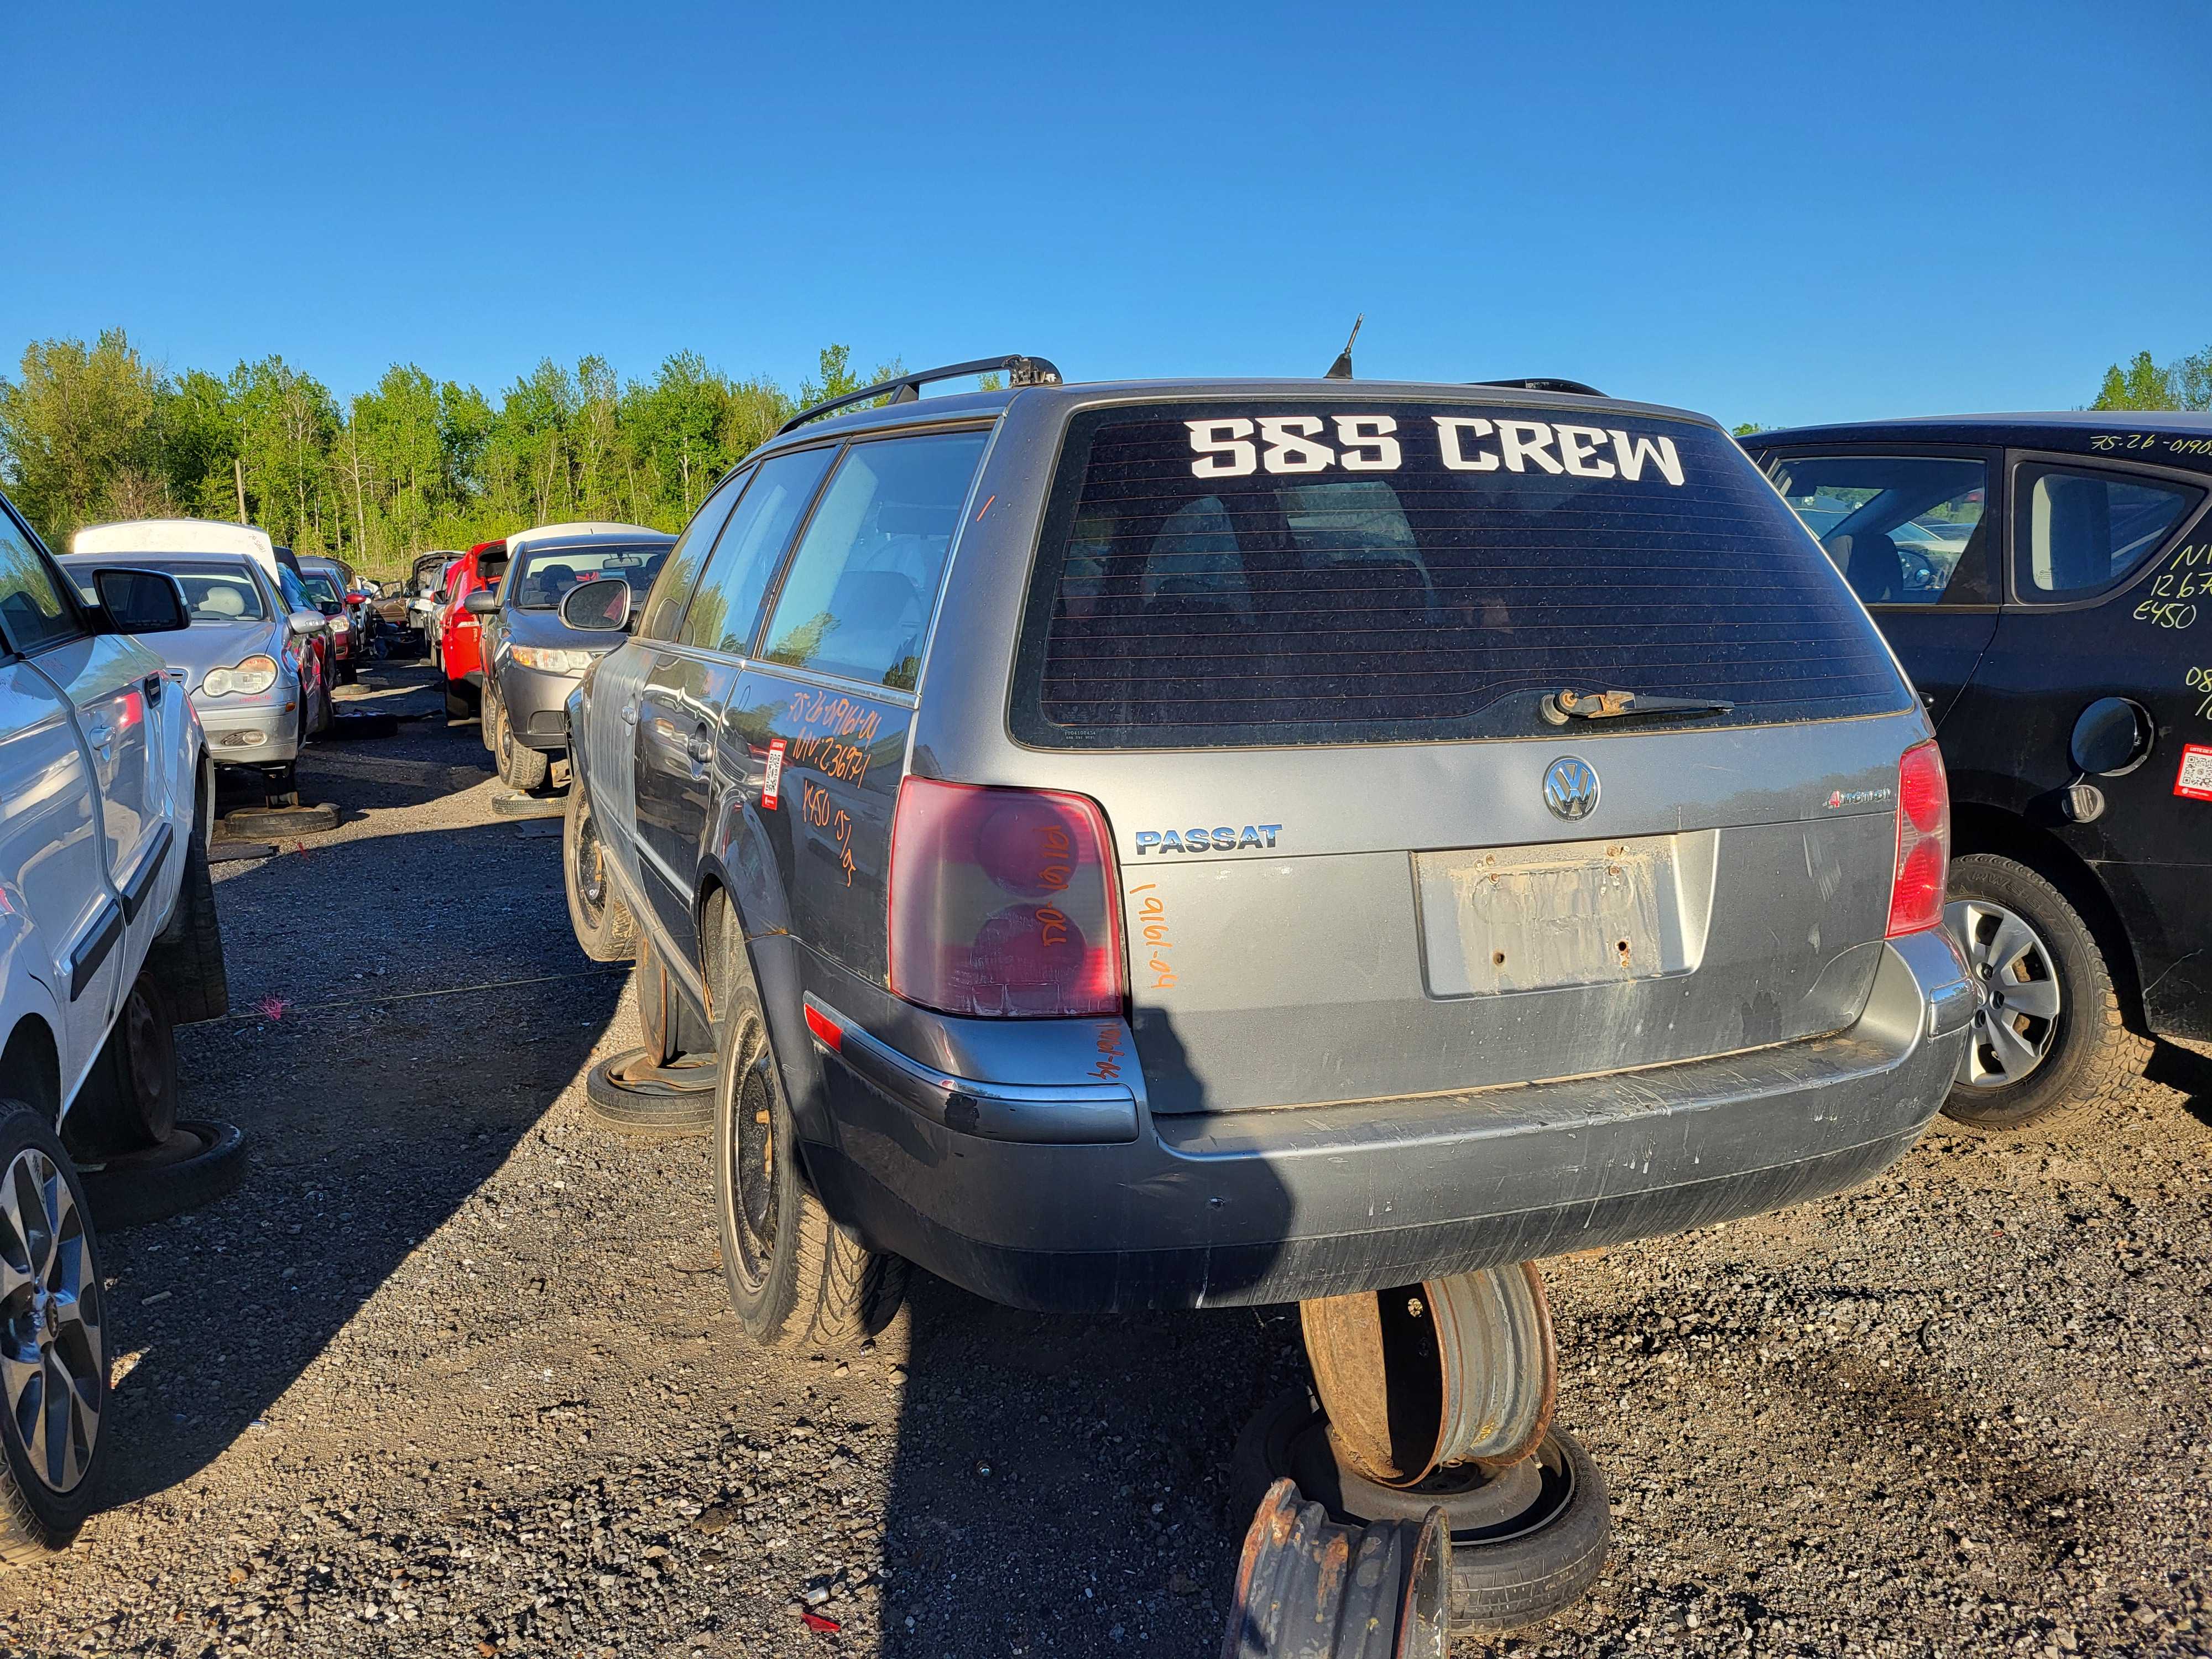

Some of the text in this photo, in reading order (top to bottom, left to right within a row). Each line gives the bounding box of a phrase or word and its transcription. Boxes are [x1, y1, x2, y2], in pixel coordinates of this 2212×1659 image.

[1183, 415, 1686, 487] S&S CREW
[2133, 599, 2197, 629] E450
[1136, 824, 1282, 855] PASSAT
[1129, 883, 1178, 989] 19161-04
